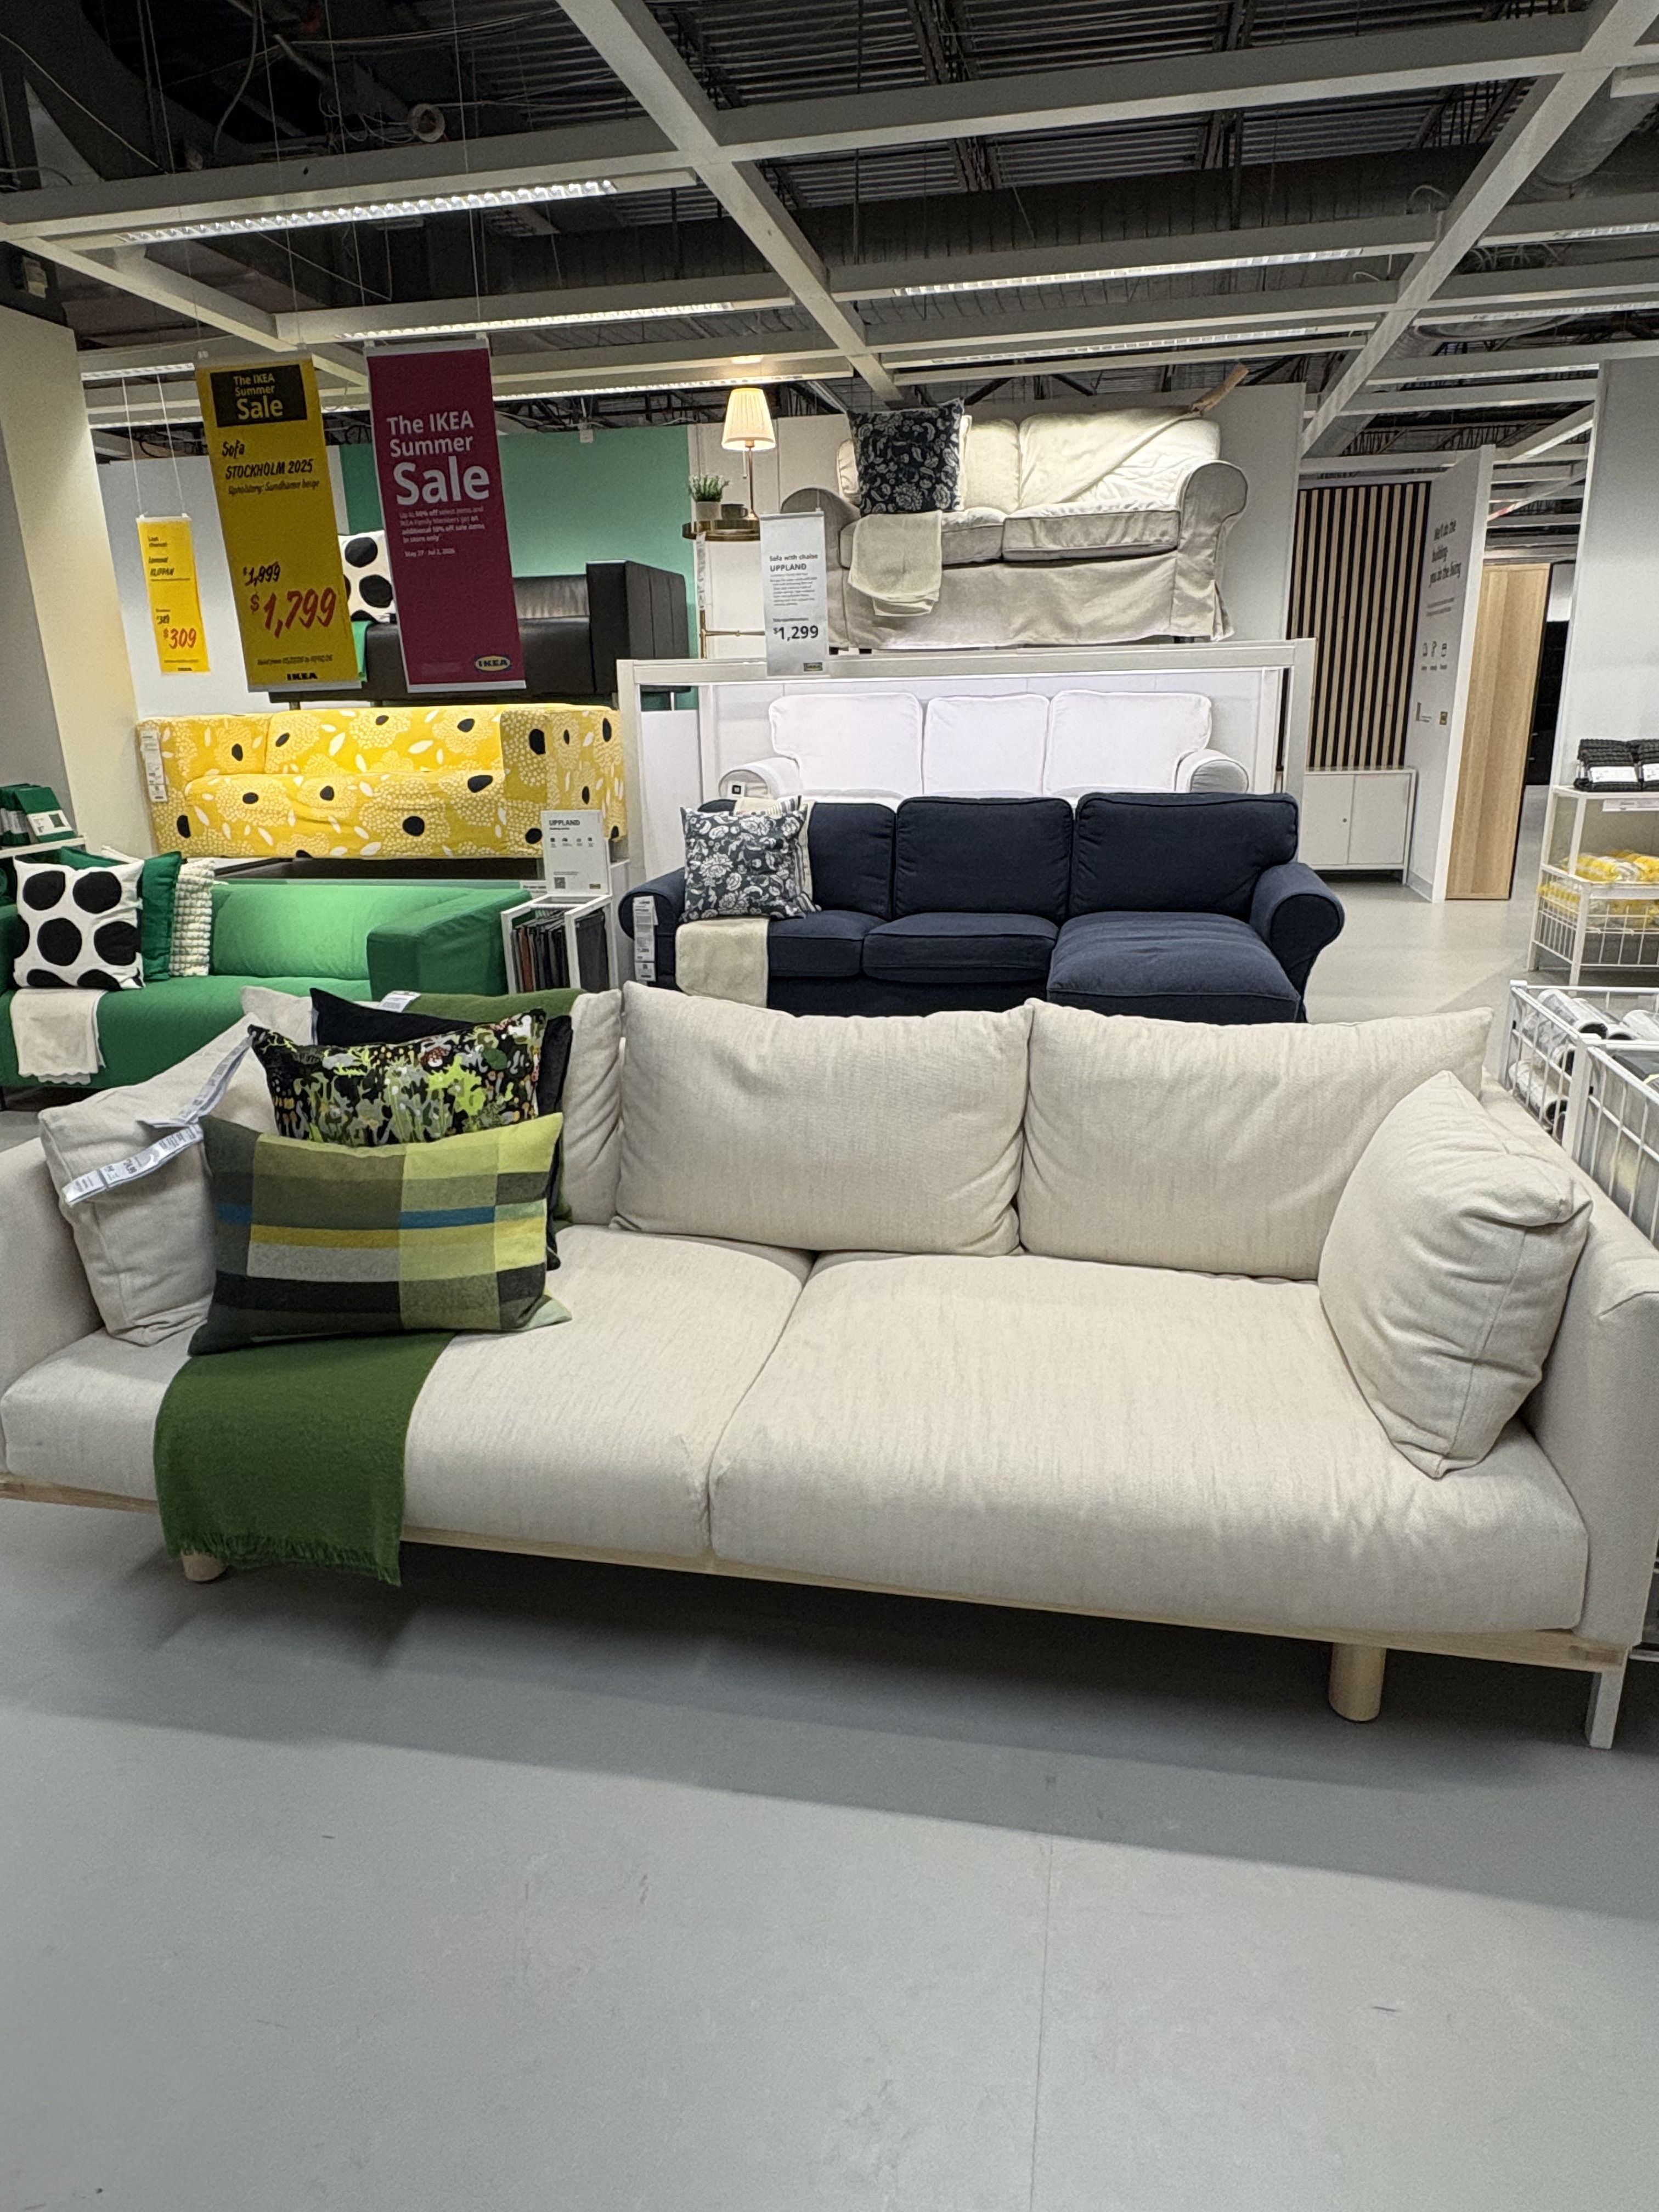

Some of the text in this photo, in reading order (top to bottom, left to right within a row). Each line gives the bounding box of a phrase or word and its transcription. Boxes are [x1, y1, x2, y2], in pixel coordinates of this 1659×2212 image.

[233, 373, 275, 386] The IKEA
[235, 385, 275, 397] Summer
[236, 394, 283, 420] Sale
[386, 410, 475, 435] The IKEA
[221, 439, 245, 459] Sofa
[390, 436, 473, 458] Summer
[225, 458, 314, 480] STOCKHOLM 2025
[393, 455, 490, 506] Sale
[770, 563, 806, 572] UPPLAND
[250, 587, 337, 638] $1,799
[163, 628, 196, 650] $309
[772, 624, 819, 641] $1,299
[286, 672, 318, 681] IKEA
